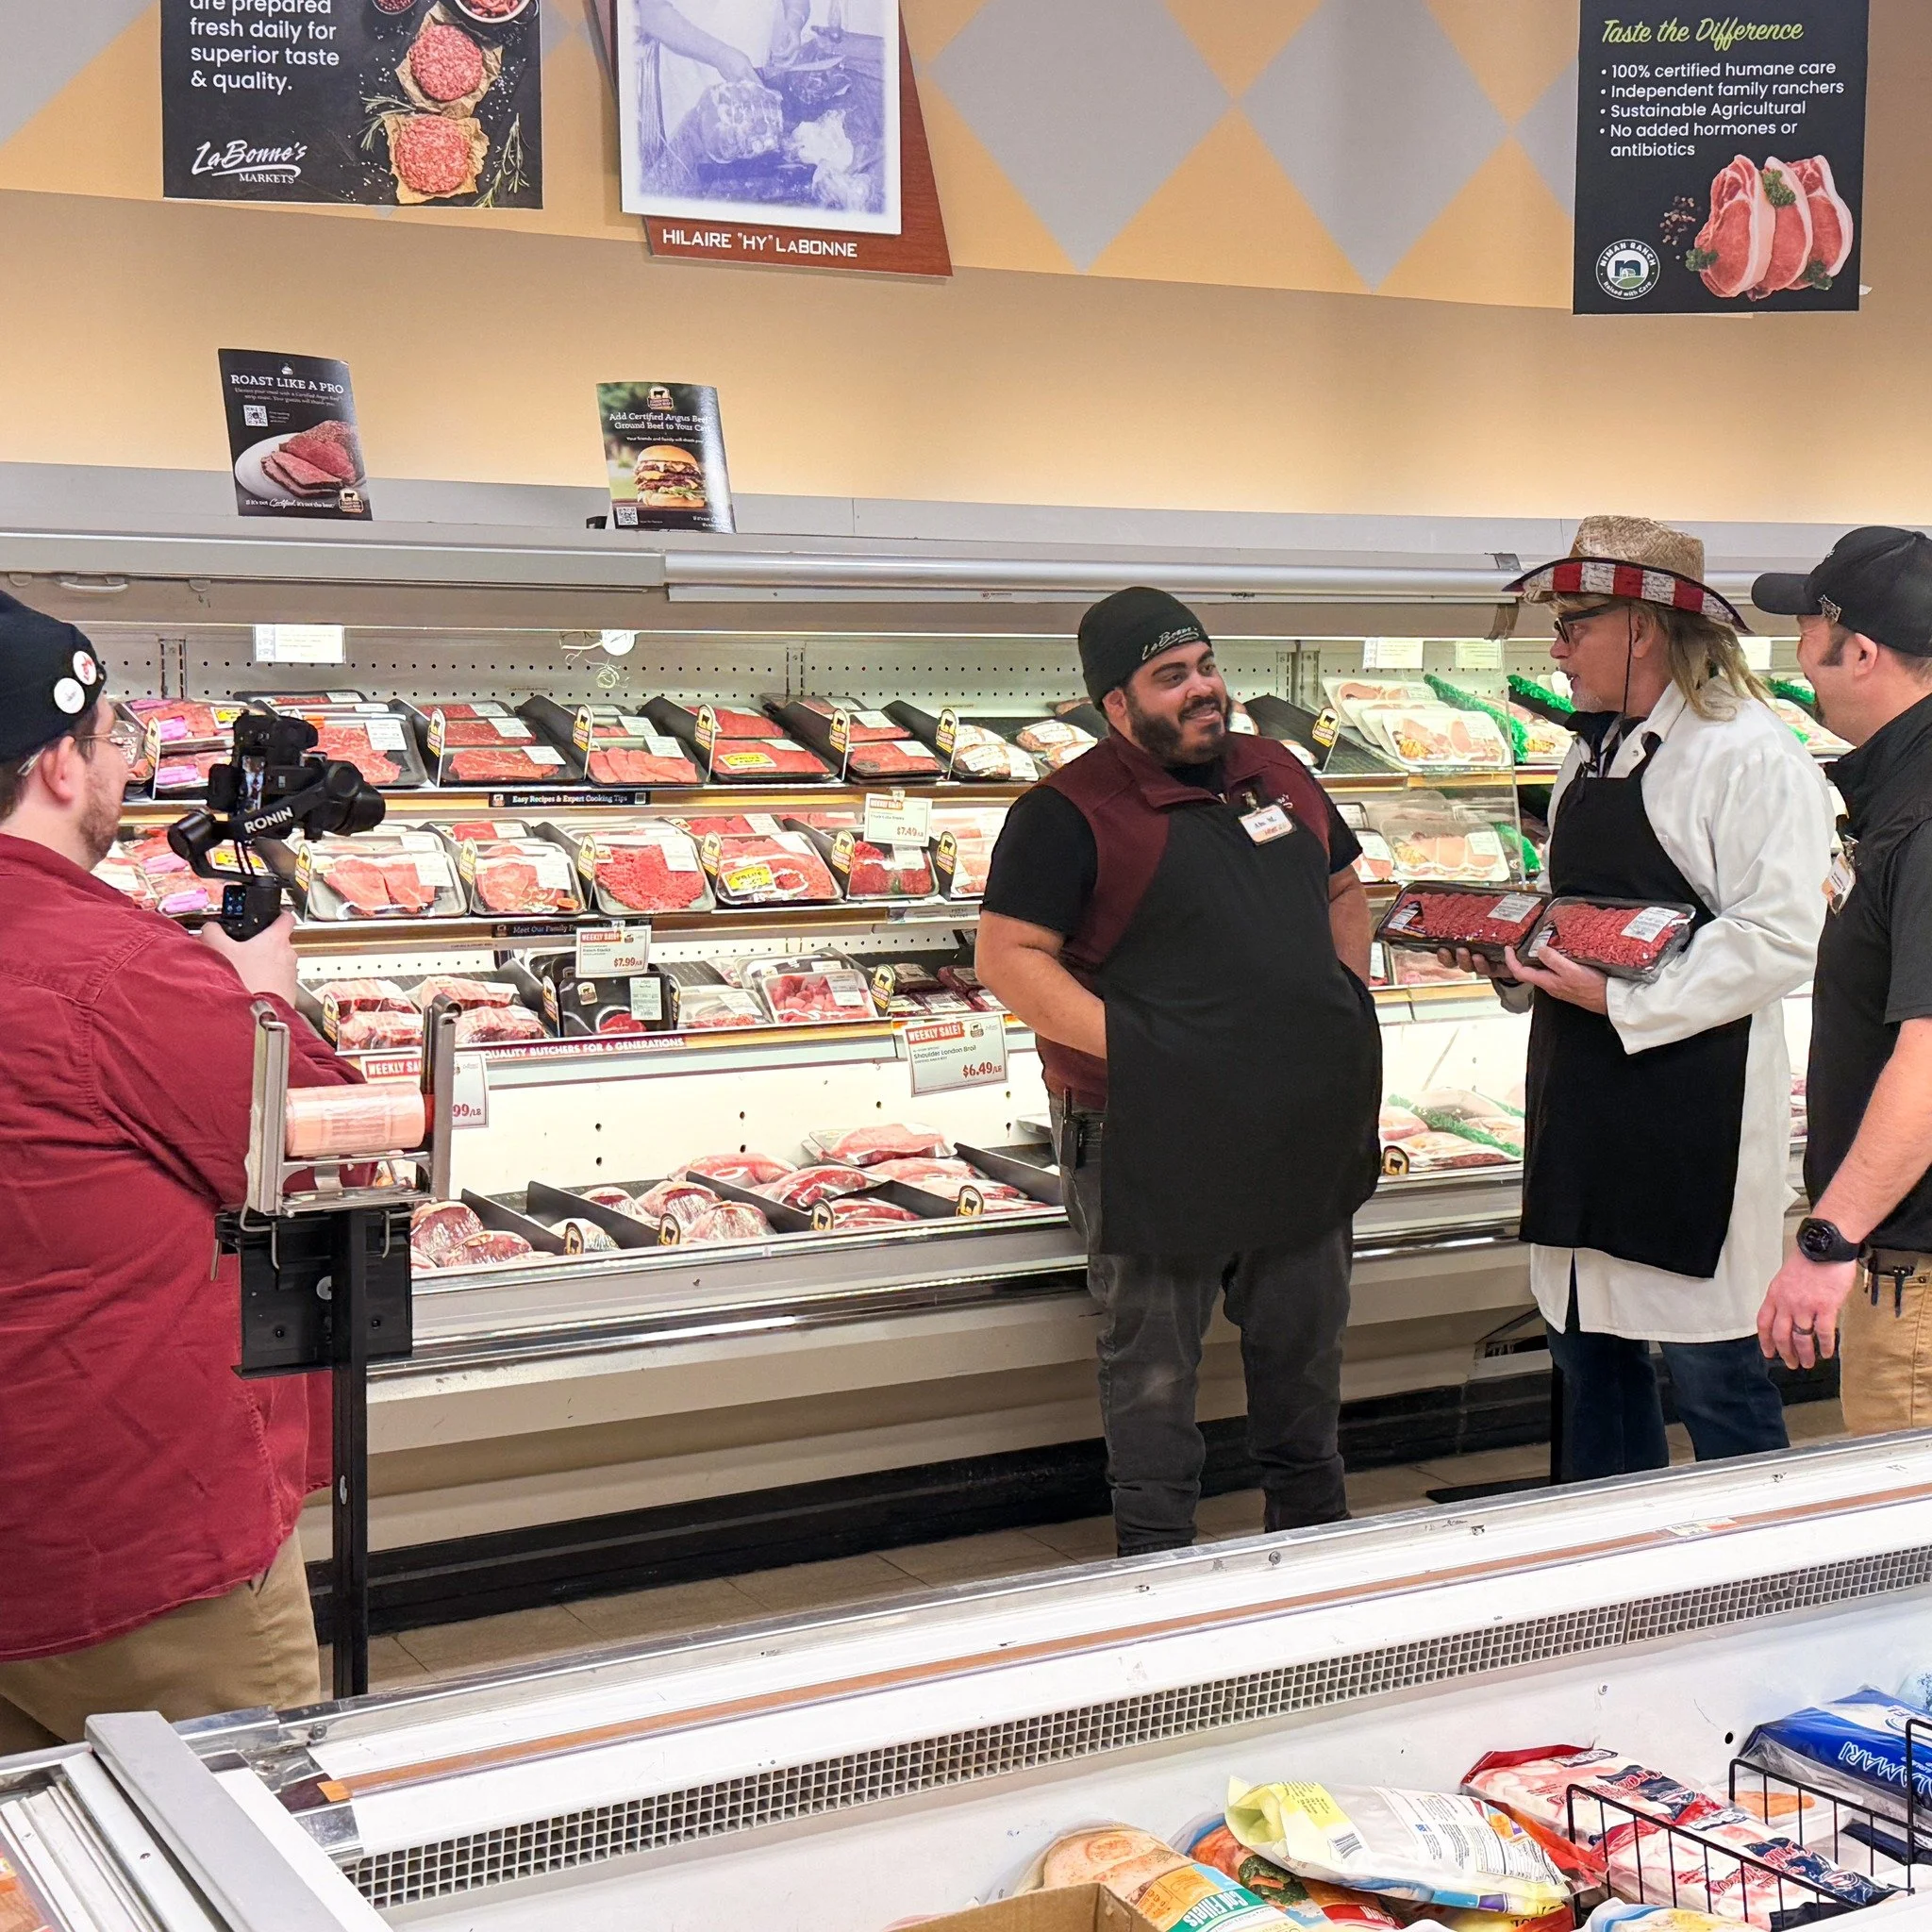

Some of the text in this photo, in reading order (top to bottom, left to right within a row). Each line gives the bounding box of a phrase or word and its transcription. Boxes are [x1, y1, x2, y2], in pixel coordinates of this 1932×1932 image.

[190, 0, 331, 17] are prepared
[191, 17, 337, 44] fresh daily for
[1602, 17, 1804, 52] Taste the Difference
[191, 45, 340, 67] superior taste
[1611, 61, 1837, 78] 100% certified humane care
[191, 70, 292, 95] & quality.
[1610, 80, 1844, 102] Independent family ranchers
[1610, 100, 1807, 120] Sustainable Agricultural
[1610, 121, 1798, 137] No added hormones or
[192, 140, 308, 175] LaBonne's
[1610, 142, 1695, 158] antibiotics
[239, 174, 294, 184] MARKETS
[662, 228, 732, 249] HILAIRE
[737, 232, 774, 251] "HY"
[1630, 242, 1657, 266] RANCH
[230, 375, 344, 394] ROAST LIKE A PRO
[665, 414, 691, 423] Angus
[530, 795, 555, 804] Recipes
[563, 795, 584, 804] Expert
[586, 794, 613, 803] Cooking
[244, 807, 293, 834] RONIN
[513, 925, 529, 934] Meet
[531, 924, 544, 933] Our
[545, 924, 567, 933] Family
[581, 932, 603, 941] WEEKLY
[908, 1024, 961, 1041] WEEKLY SALE!
[484, 1038, 685, 1059] QUALITY BUTCHERS FOR 6 GENERATIONS
[913, 1050, 941, 1059] Shoulder
[941, 1047, 962, 1056] London
[963, 1044, 976, 1053] Broil
[368, 1062, 405, 1075] WEEKLY
[1216, 1890, 1249, 1910] Cod
[1182, 1895, 1228, 1927] Fillets
